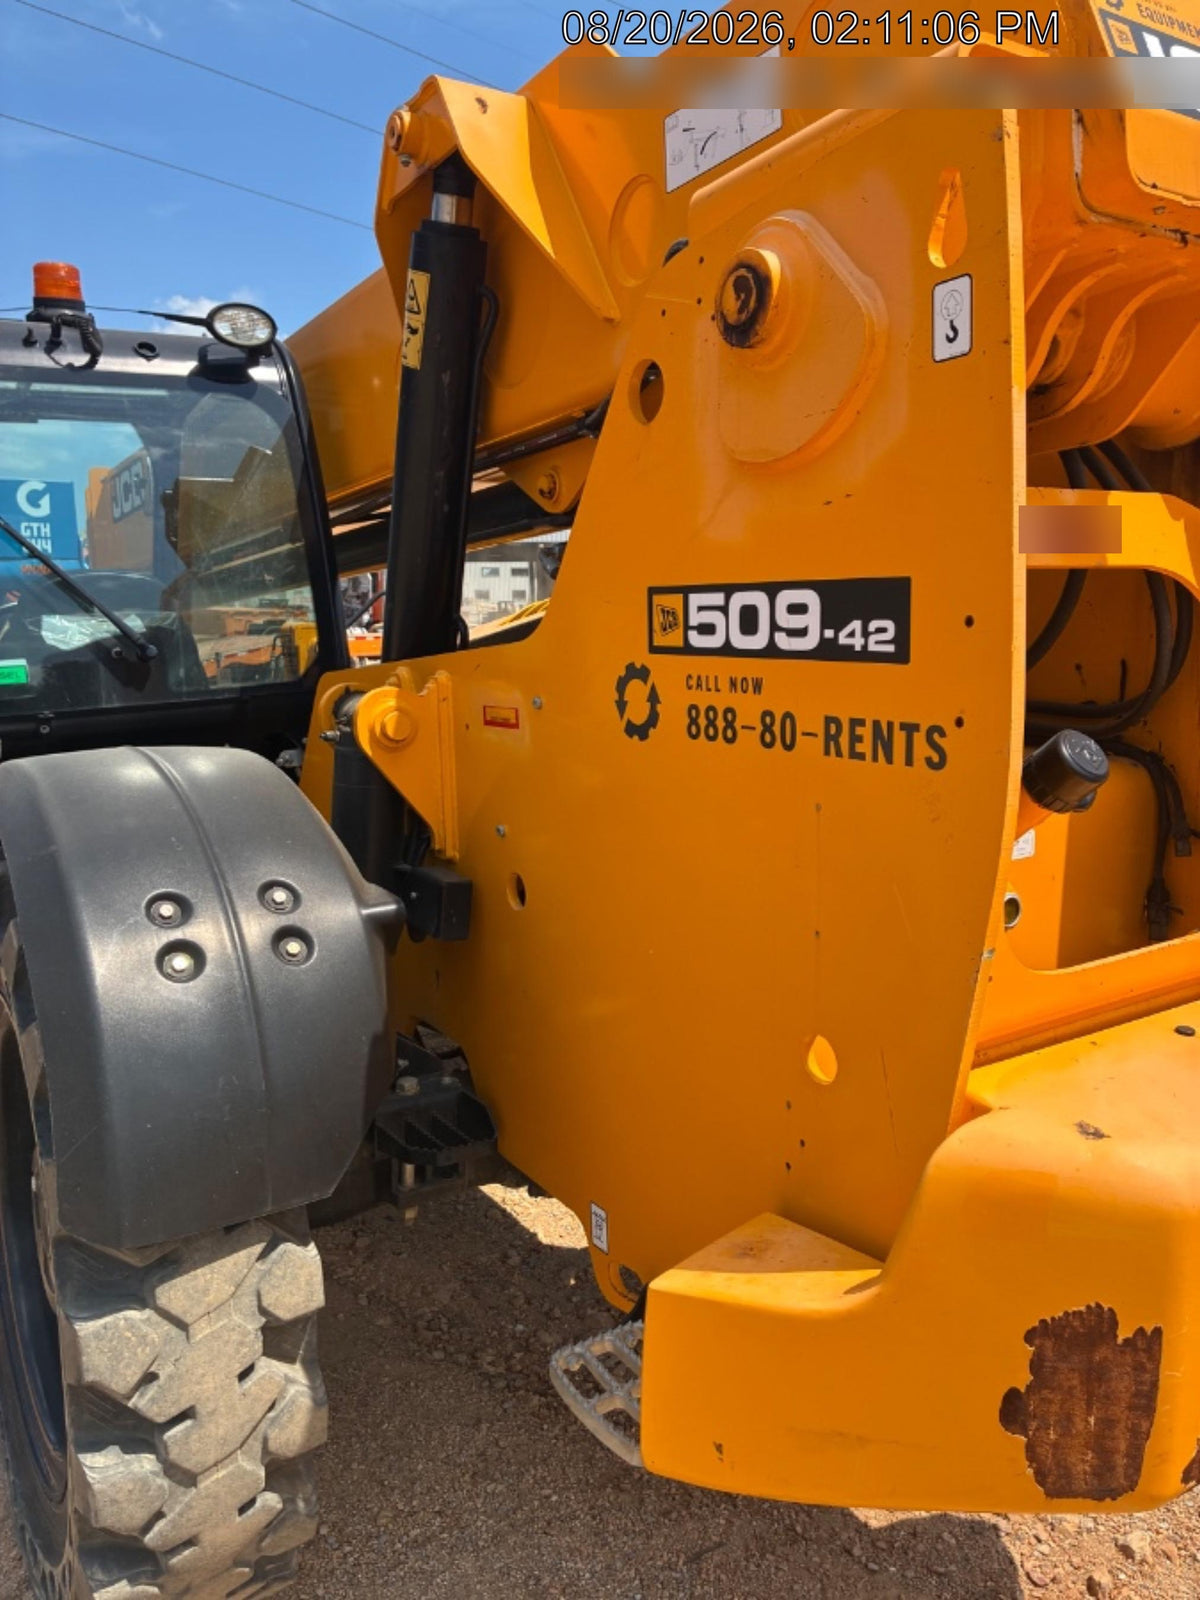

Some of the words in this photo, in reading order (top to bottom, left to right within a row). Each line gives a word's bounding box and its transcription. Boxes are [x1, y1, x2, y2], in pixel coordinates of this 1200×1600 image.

[22, 538, 53, 554] 44
[687, 588, 896, 653] 509-42
[685, 674, 721, 693] CALL
[729, 676, 764, 696] NOW
[686, 703, 948, 772] 888-80-RENTS
